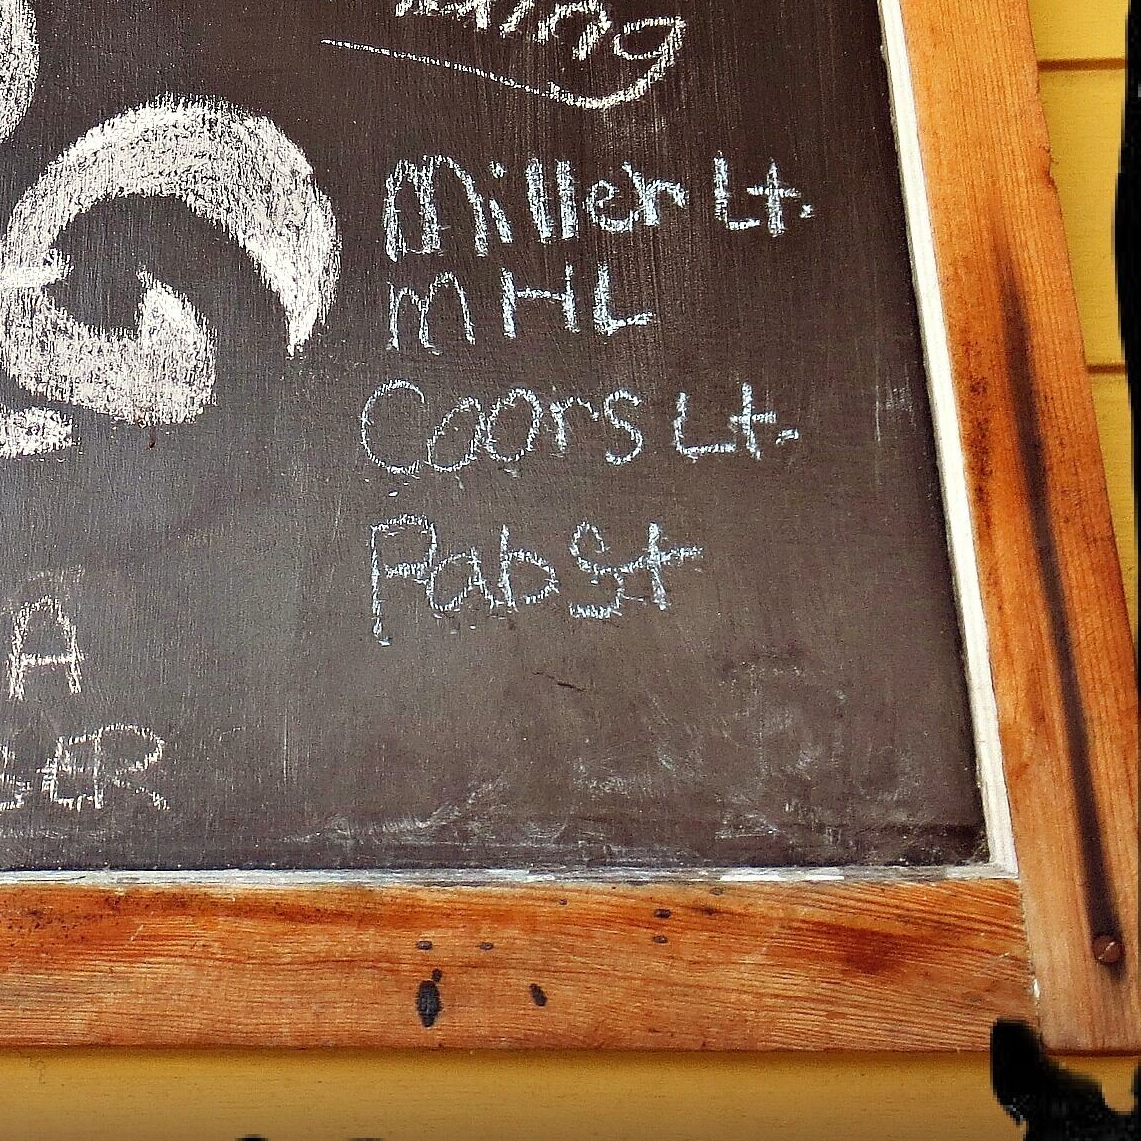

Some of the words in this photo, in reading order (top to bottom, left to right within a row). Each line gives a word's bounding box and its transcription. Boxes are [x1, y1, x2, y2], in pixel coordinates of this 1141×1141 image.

[382, 155, 689, 261] Miller
[714, 150, 814, 236] Lt.
[361, 378, 645, 475] Coors
[371, 513, 703, 646] Pabst
